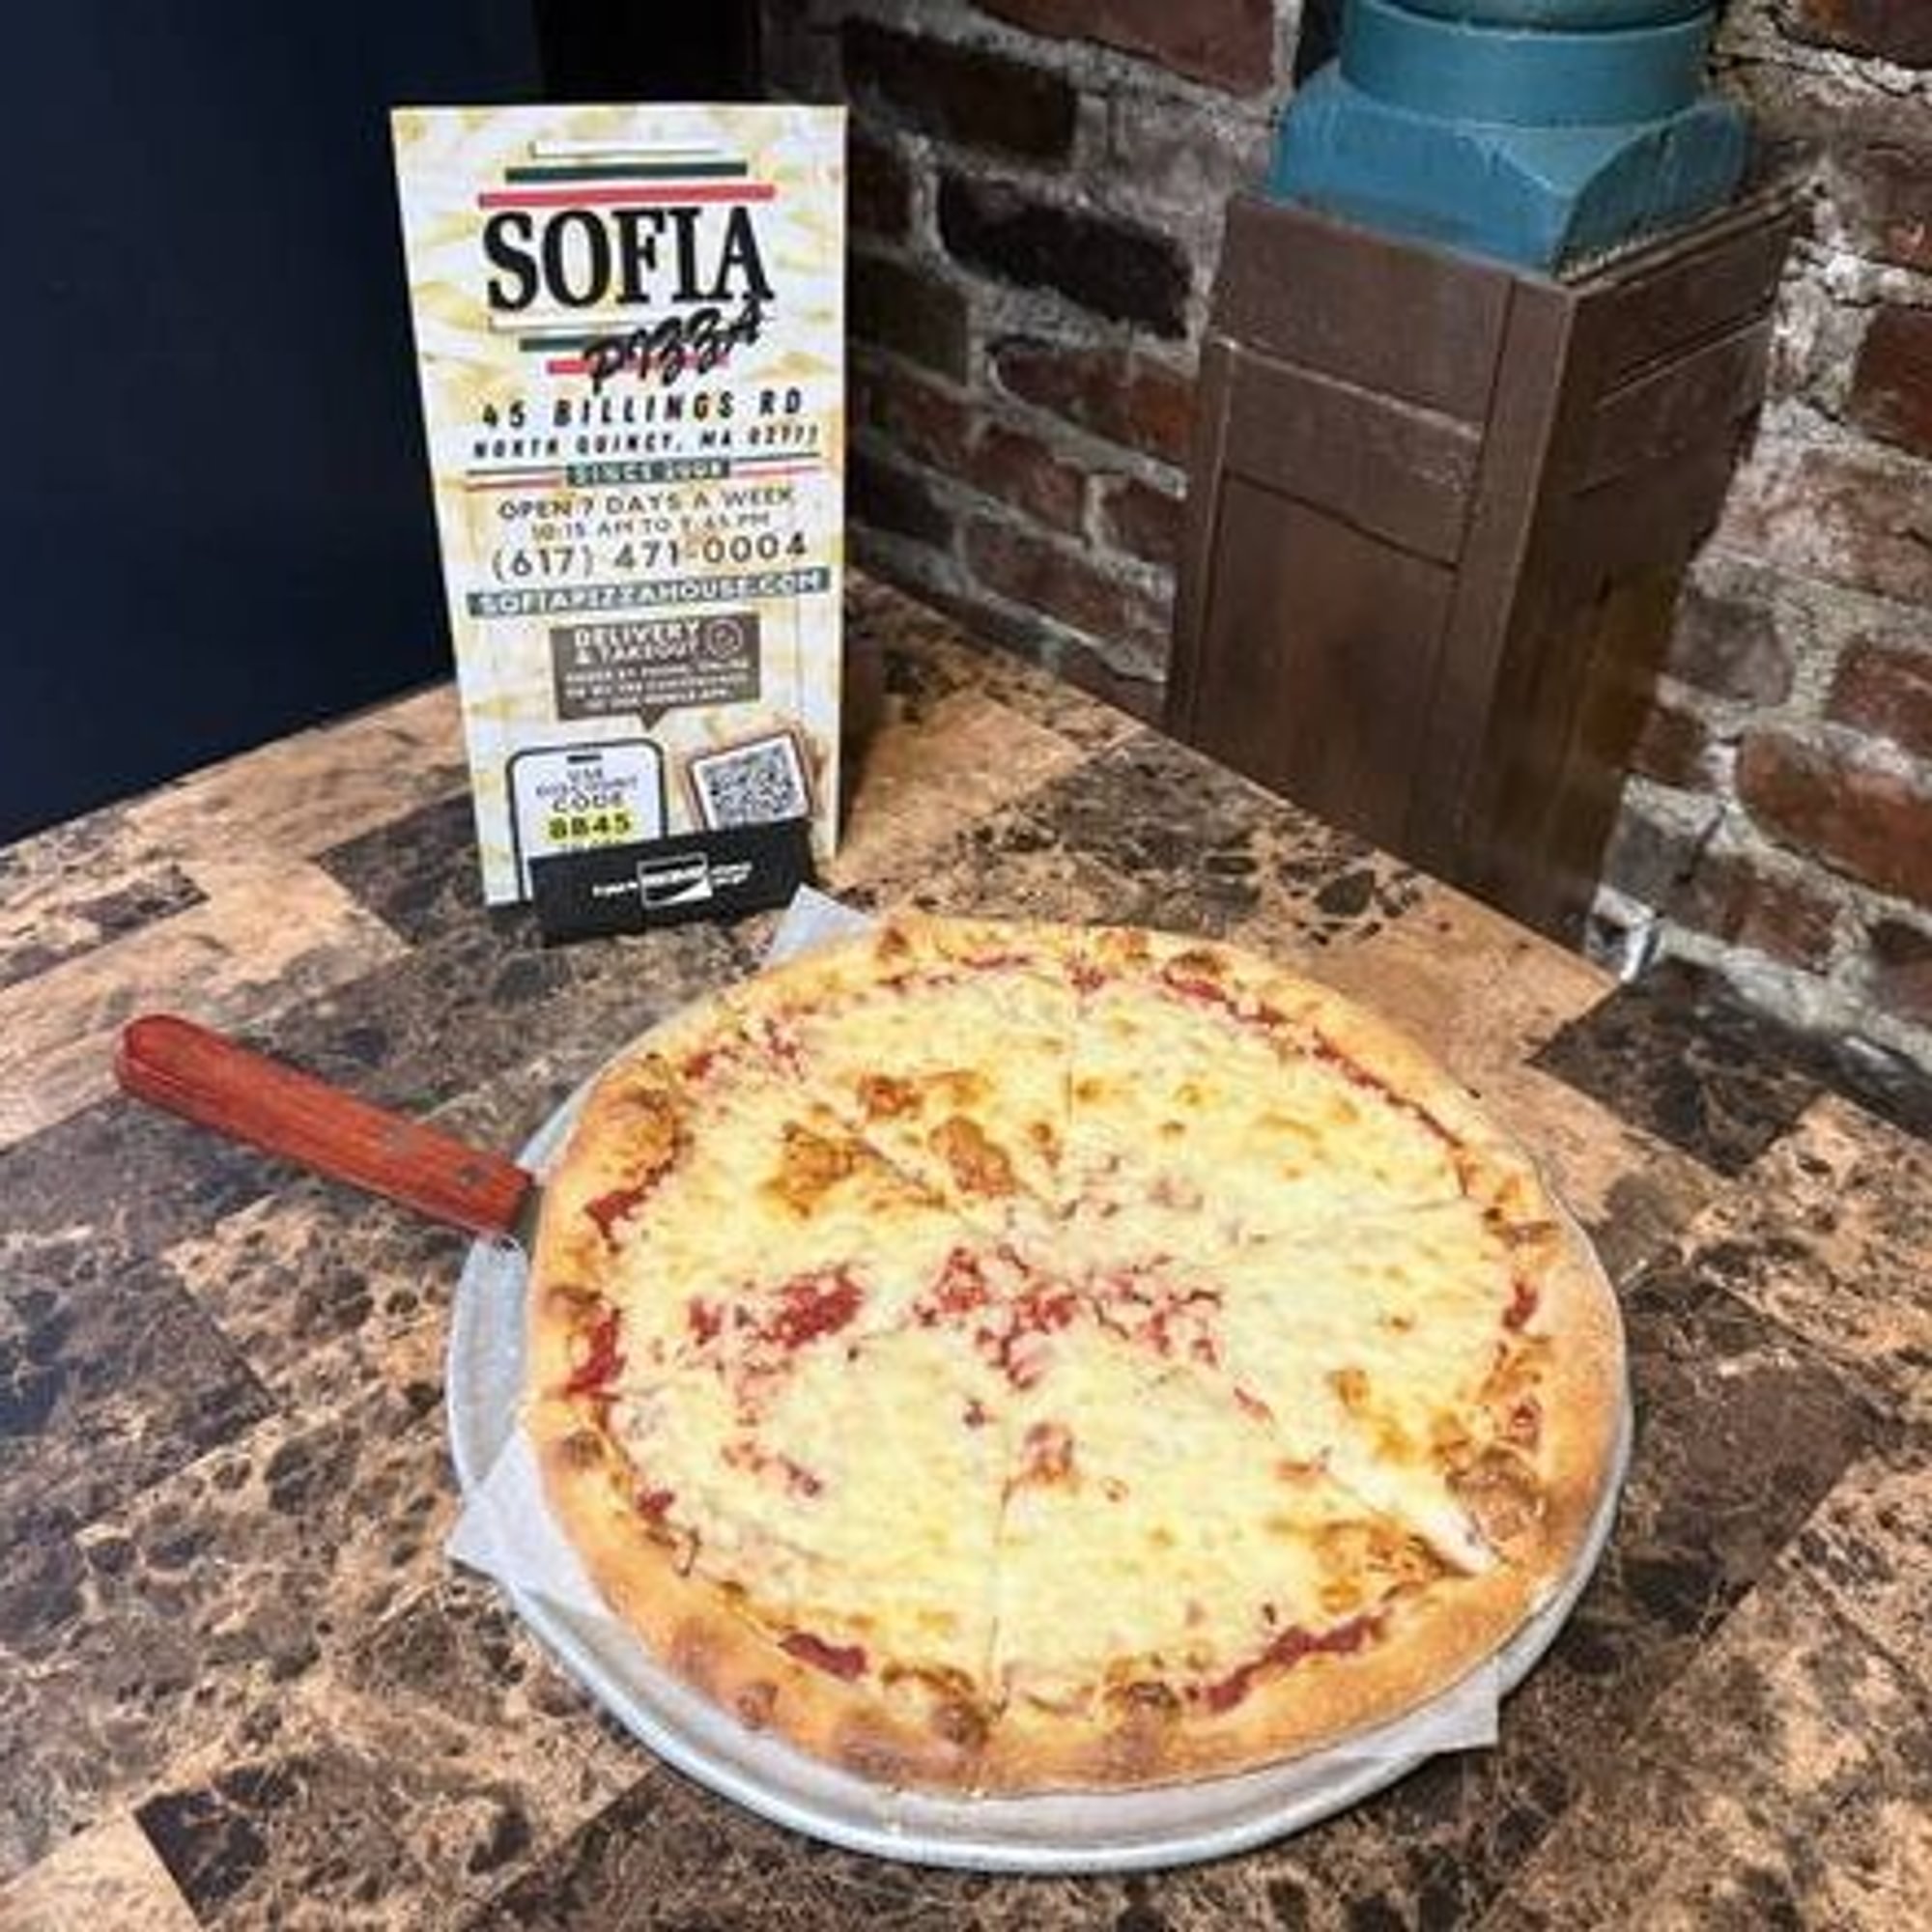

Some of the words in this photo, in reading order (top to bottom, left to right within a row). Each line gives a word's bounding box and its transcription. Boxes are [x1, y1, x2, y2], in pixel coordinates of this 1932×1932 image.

[482, 206, 777, 312] SOFIA
[583, 298, 765, 395] PIZZA
[483, 399, 526, 427] 45
[554, 391, 734, 426] BILLINGS
[759, 387, 801, 415] RD
[473, 438, 558, 459] NORTH
[577, 433, 682, 455] QUINCY,
[700, 430, 731, 447] MA
[498, 499, 572, 521] OPEN
[580, 498, 594, 517] 7
[606, 494, 681, 517] DAYS
[694, 491, 709, 508] A
[724, 486, 792, 507] WEEK
[598, 521, 633, 537] AM
[643, 518, 671, 534] TO
[737, 511, 770, 527] PM
[493, 543, 594, 580] (617)
[614, 531, 808, 568] 471-0004
[575, 618, 700, 648] DELIVERY
[552, 791, 622, 813] CODE
